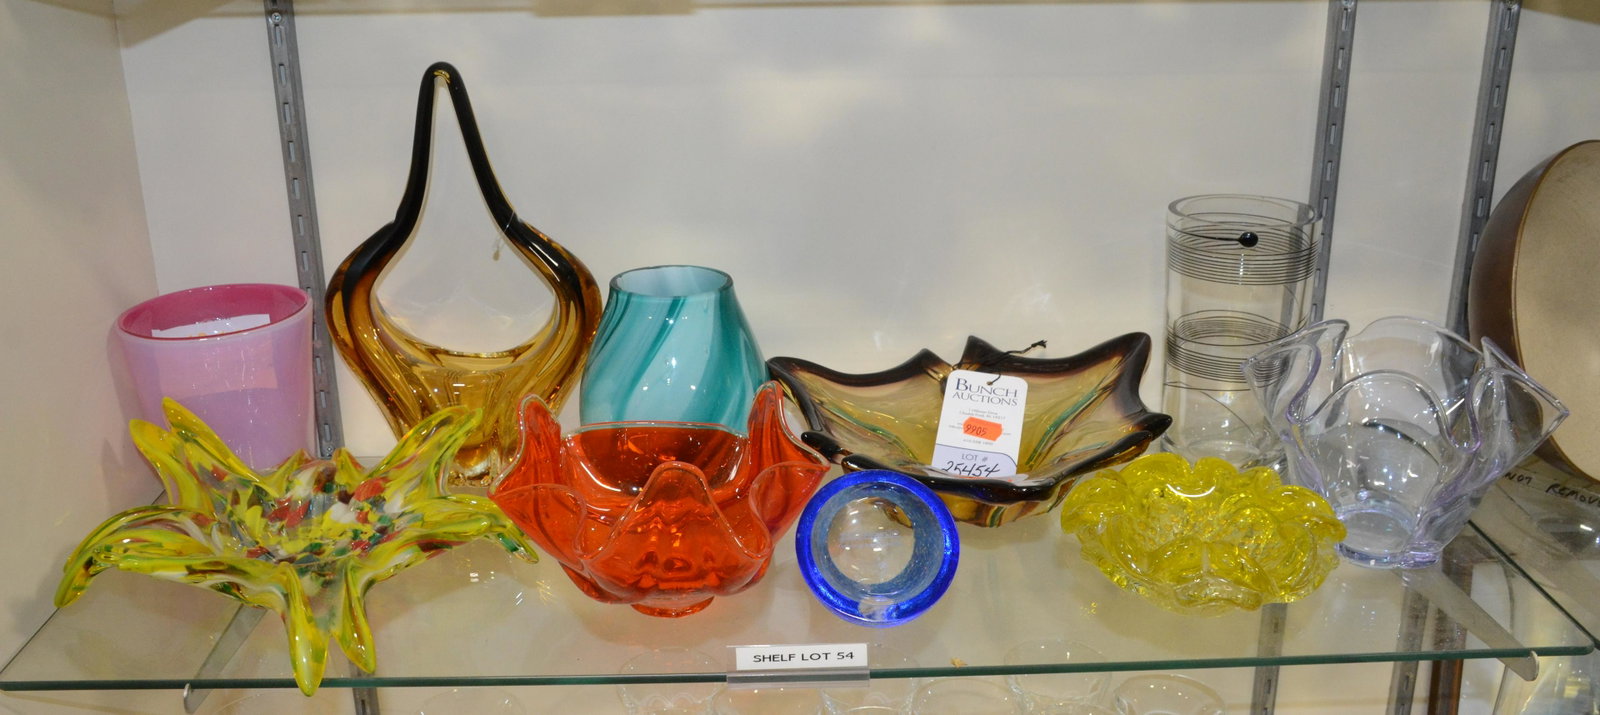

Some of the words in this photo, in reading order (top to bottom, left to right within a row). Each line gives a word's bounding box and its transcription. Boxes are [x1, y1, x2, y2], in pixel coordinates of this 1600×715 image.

[952, 391, 1018, 406] AUCTIONS
[965, 424, 988, 437] 9905
[961, 453, 978, 462] LOT
[941, 460, 1000, 478] 25454
[1503, 471, 1533, 485] NOT
[753, 653, 796, 663] SHELF
[801, 652, 831, 661] LOT
[836, 651, 854, 660] 54
